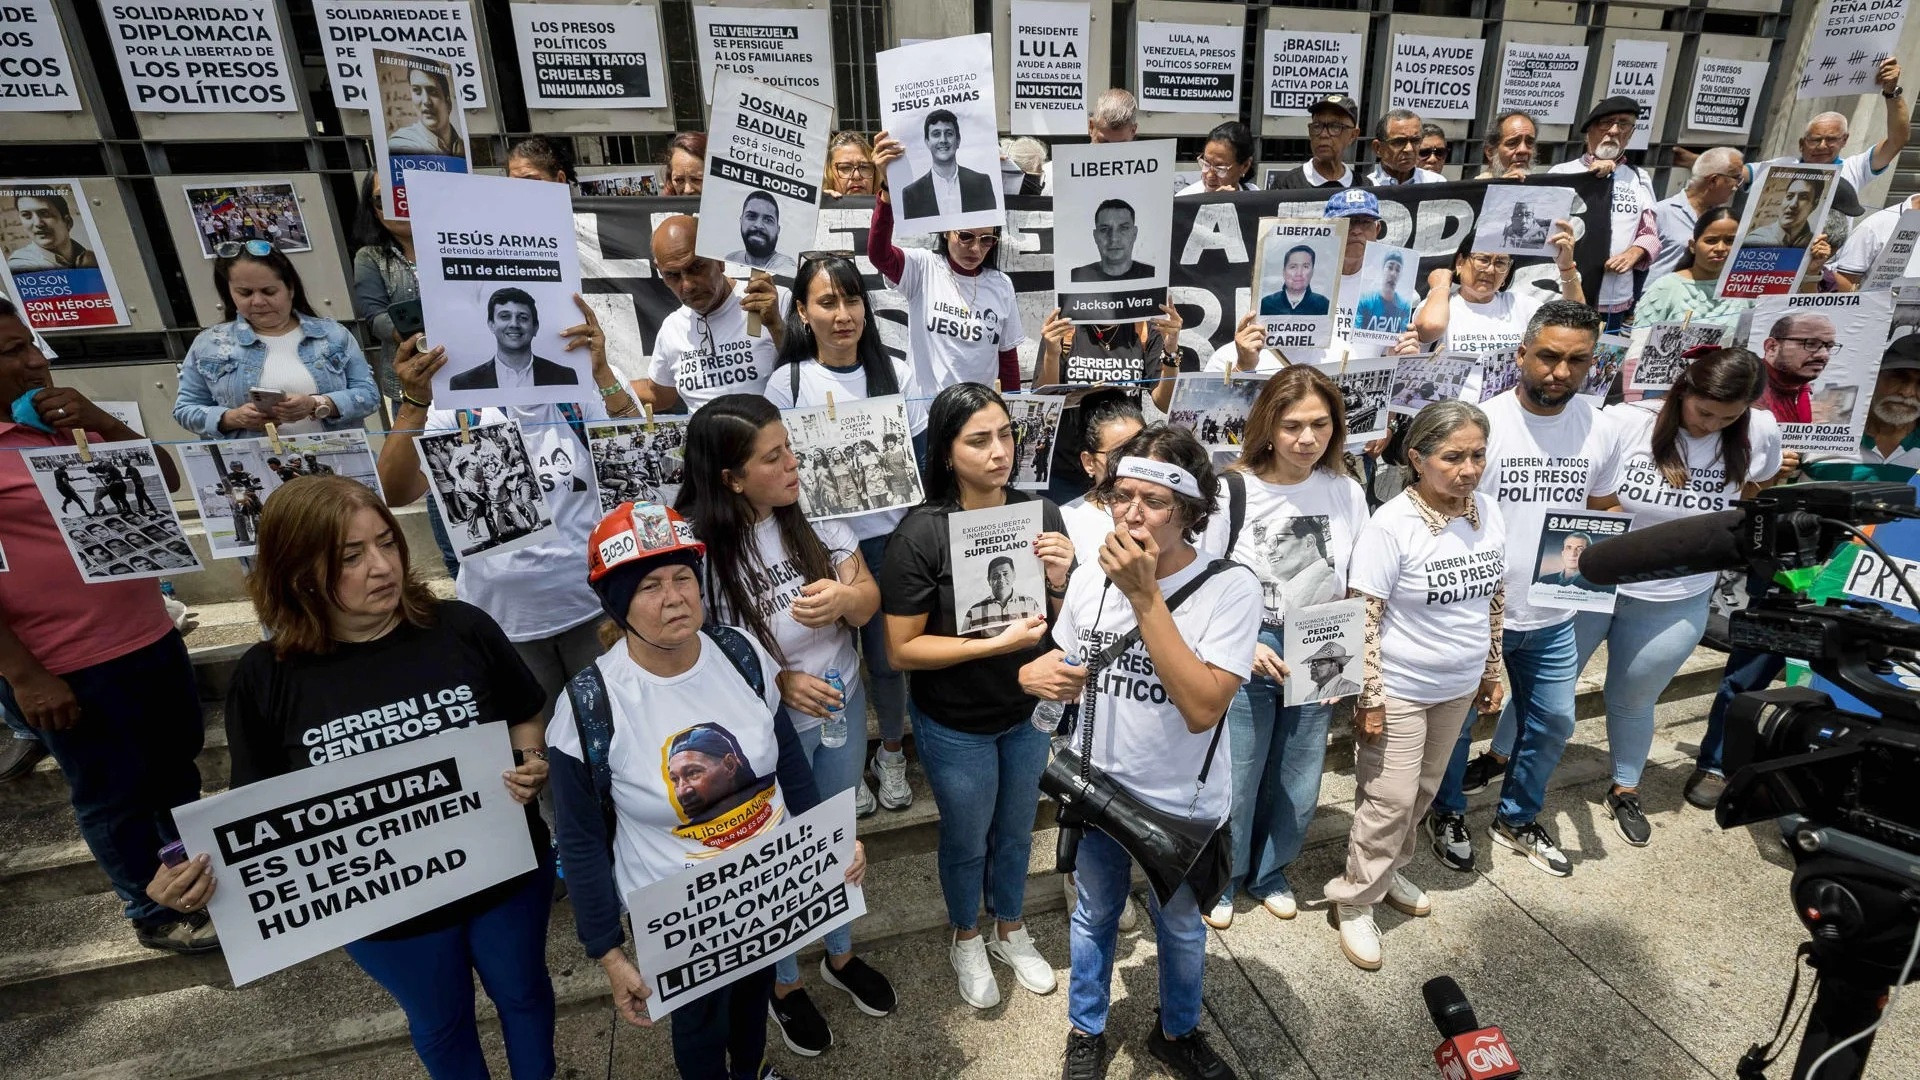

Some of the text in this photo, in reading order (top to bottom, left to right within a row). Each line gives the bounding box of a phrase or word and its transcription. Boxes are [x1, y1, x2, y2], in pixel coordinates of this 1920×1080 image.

[113, 6, 264, 22] SOLIDARIDAD Y
[326, 8, 461, 21] SOLIDARIEDADE E
[1828, 11, 1900, 26] ESTÁ SIENDO
[119, 24, 272, 41] DIPLOMACIA
[329, 26, 468, 42] DIPLOMACIA
[531, 21, 615, 34] LOS PRESOS
[711, 26, 794, 38] EN VENEZUELA
[1018, 25, 1078, 36] PRESIDENTE
[1825, 22, 1896, 37] TORTURADO
[534, 36, 607, 49] POLÍTICOS
[713, 39, 783, 50] SE PERSIGUE
[1019, 40, 1078, 58] LULA
[125, 45, 274, 57] POR LA LIBERTAD DE
[714, 52, 813, 63] A LOS FAMILIARES
[1143, 46, 1236, 58] VENEZUELA, PRESOS
[1397, 44, 1473, 59] LULA, AYUDE
[536, 54, 645, 66] SUFREN TRATOS
[1617, 60, 1658, 69] PRESIDENTE
[130, 61, 279, 77] LOS PRESOS
[539, 69, 612, 81] CRUELES E
[1272, 66, 1349, 78] DIPLOMACIA
[1704, 63, 1742, 75] LOS PRESOS
[1159, 75, 1219, 86] TRATAMENTO
[1271, 79, 1349, 90] ACTIVA POR LA
[1505, 79, 1539, 88] LIBERDADE
[1615, 71, 1654, 86] LULA
[136, 80, 286, 104] POLÍTICOS
[541, 83, 625, 96] INHUMANOS
[899, 82, 971, 100] INMEDIATA PARA
[1017, 84, 1081, 97] INJUSTICIA
[1393, 77, 1471, 96] POLÍTICOS
[1503, 88, 1565, 98] PRESOS POLÍTICOS
[892, 90, 980, 113] JESÚS ARMAS
[1014, 101, 1084, 111] EN VENEZUELA
[1393, 97, 1469, 110] EN VENEZUELA
[739, 92, 808, 127] JOSNAR
[1696, 104, 1738, 115] PROLONGADO
[737, 113, 805, 146] BADUEL
[394, 159, 446, 171] NO SON
[730, 146, 804, 179] torturado
[1070, 158, 1159, 177] LIBERTAD
[1276, 226, 1331, 237] LIBERTAD
[437, 230, 558, 249] JESÚS ARMAS
[439, 246, 559, 258] detenido arbitrariamente
[1735, 261, 1776, 271] PRESOS
[17, 275, 68, 286] NO SON
[21, 286, 72, 297] PRESOS
[1726, 283, 1764, 293] CIVILES
[26, 299, 112, 312] SON HÉROES
[1072, 297, 1153, 311] Jackson Vera
[1789, 295, 1860, 307] PERIODISTA
[31, 311, 79, 322] CIVILES
[934, 301, 982, 320] LIBEREN A
[927, 317, 982, 341] JESÚS
[1267, 323, 1316, 332] RICARDO
[1266, 335, 1315, 347] CARIEL
[680, 350, 754, 375] LOS PRESOS
[1068, 355, 1122, 369] CIERREN
[679, 366, 758, 391] POLÍTICOS
[1067, 367, 1131, 380] CENTROS
[840, 414, 872, 425] CONTRA
[844, 430, 874, 440] CULTURA
[1783, 425, 1850, 435] JULIO ROJAS
[539, 456, 549, 467] A
[1501, 457, 1590, 468] LIBEREN A TODOS
[1500, 470, 1587, 484] LOS PRESOS
[1626, 469, 1725, 493] LOS PESOS
[1497, 483, 1585, 502] POLÍTICOS
[1617, 484, 1724, 512] POLÍTICOS
[1548, 517, 1625, 532] 8 MESES
[1754, 514, 1764, 549] VELLO
[975, 533, 1017, 547] FREDDY
[601, 536, 634, 563] 3030
[964, 540, 1028, 558] SUPERLANO
[1425, 549, 1500, 572] LIBEREN A TODO
[1427, 560, 1504, 588] LOS PRESOS
[1307, 625, 1340, 636] PEDRO
[1302, 632, 1345, 645] GUANIPA
[302, 697, 419, 746] CIERREN
[423, 684, 473, 711] LOS
[308, 712, 442, 765] CENTROS
[445, 701, 480, 723] DE
[225, 768, 450, 854] LA TORTURA
[736, 827, 748, 837] NO
[748, 821, 756, 830] ES
[239, 791, 482, 888] ES UN CRIMEN
[248, 847, 397, 913] DE LESA
[647, 827, 844, 934] SOLIDARIEDADE E
[257, 848, 467, 940] HUMANIDAD
[663, 851, 839, 950] DIPLOMACIA
[688, 881, 824, 959] ATIVA PELA
[659, 886, 847, 998] LIBERDADE
[1467, 1043, 1513, 1072] CNN
